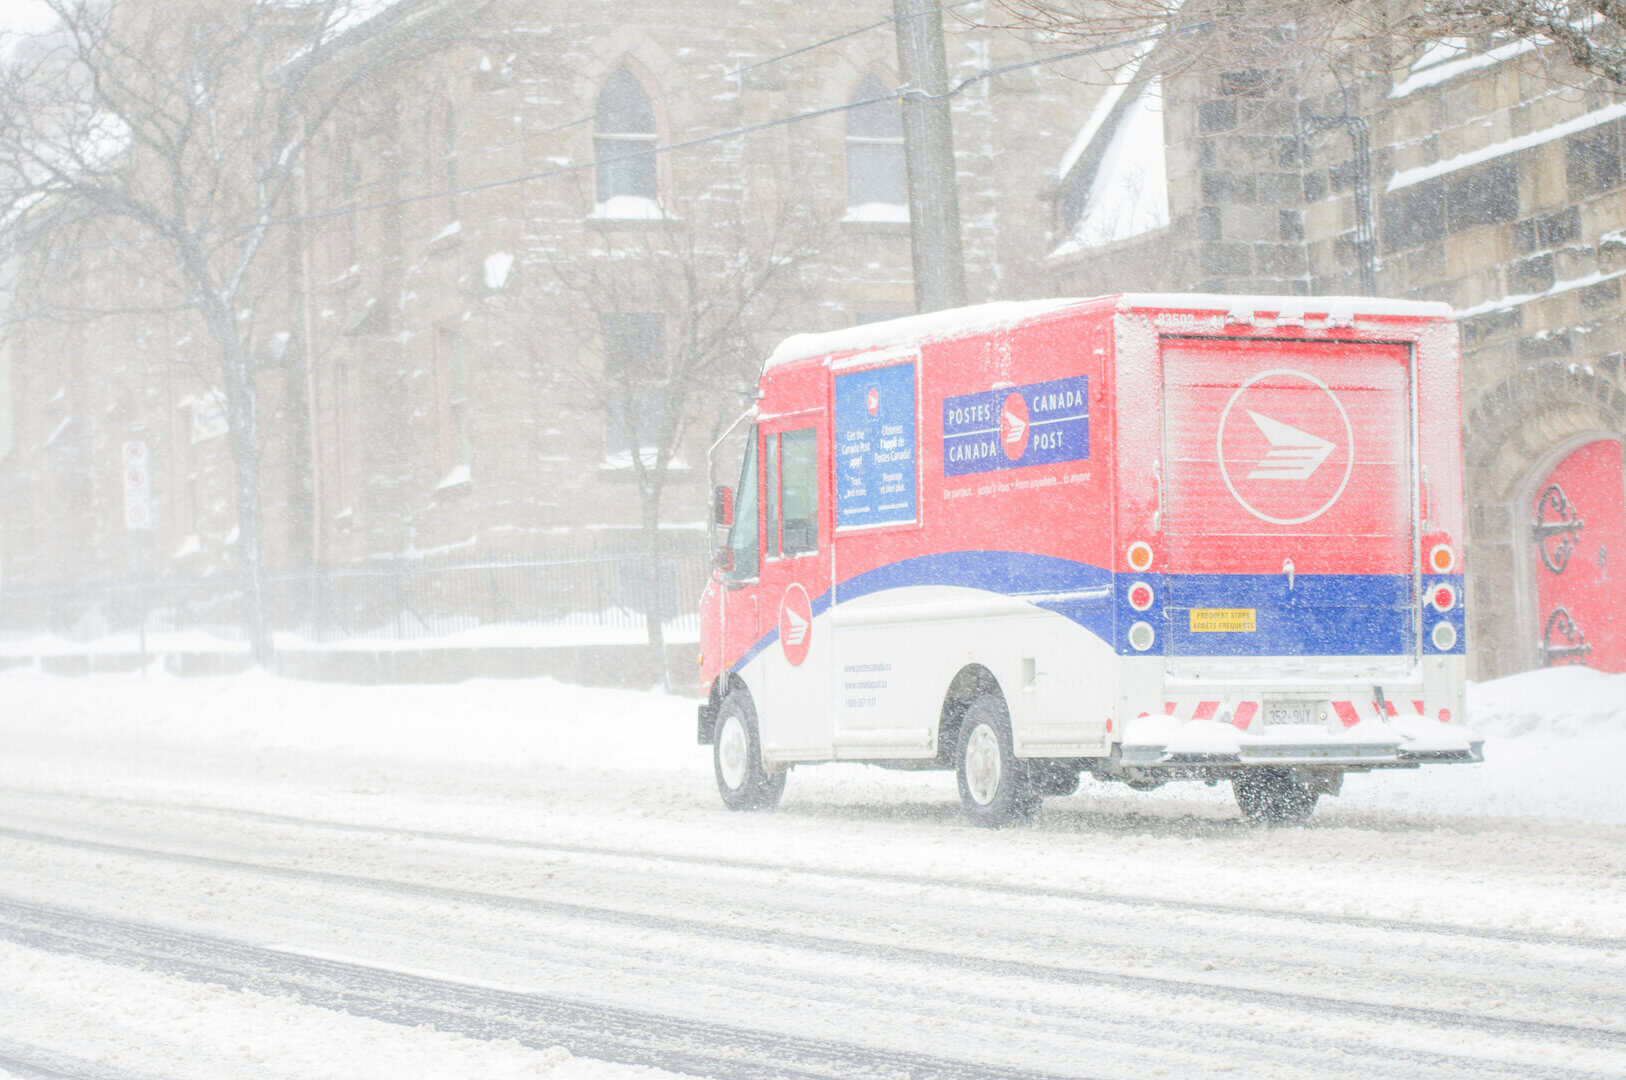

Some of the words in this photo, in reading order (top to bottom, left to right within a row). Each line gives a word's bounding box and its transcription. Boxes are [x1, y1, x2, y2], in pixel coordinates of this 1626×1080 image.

[1033, 390, 1083, 412] CANADA
[948, 404, 991, 425] POSTES
[949, 440, 997, 462] CANADA
[1033, 431, 1064, 451] POST
